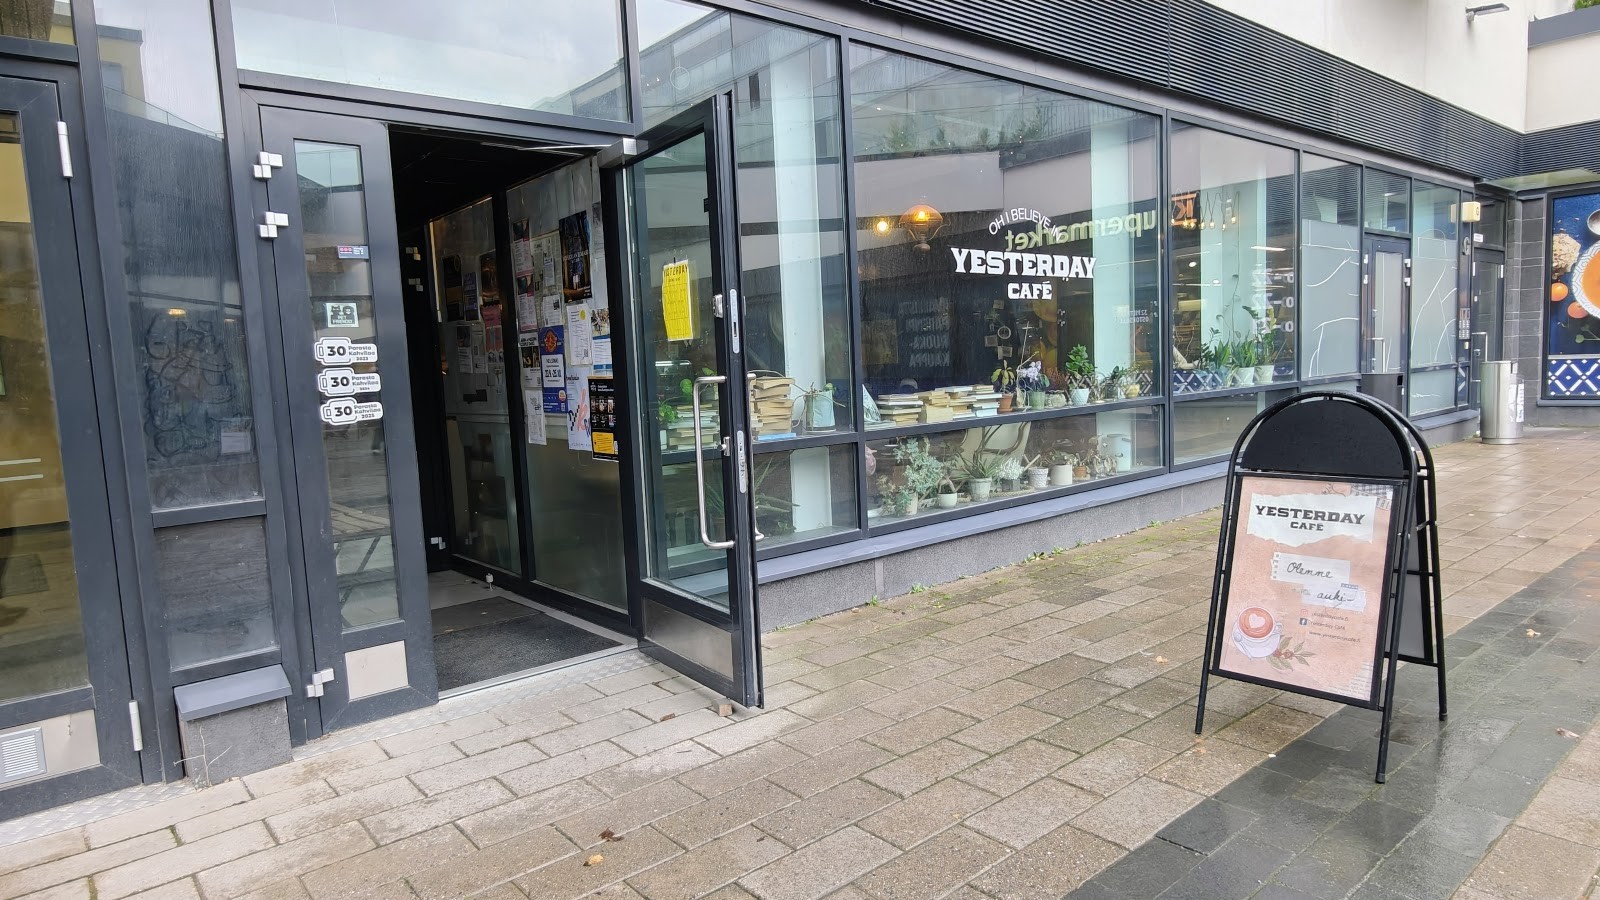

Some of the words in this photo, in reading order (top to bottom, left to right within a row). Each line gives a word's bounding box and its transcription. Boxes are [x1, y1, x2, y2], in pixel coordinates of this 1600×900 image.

[988, 214, 1005, 235] OH
[1005, 211, 1010, 224] I
[1011, 207, 1051, 231] BELIEVE
[950, 247, 1097, 280] YESTERDAY
[1007, 280, 1052, 300] CAFÉ
[327, 346, 346, 356] 30
[330, 376, 350, 388] 30
[334, 406, 352, 417] 30
[1255, 504, 1366, 525] YESTERDAY
